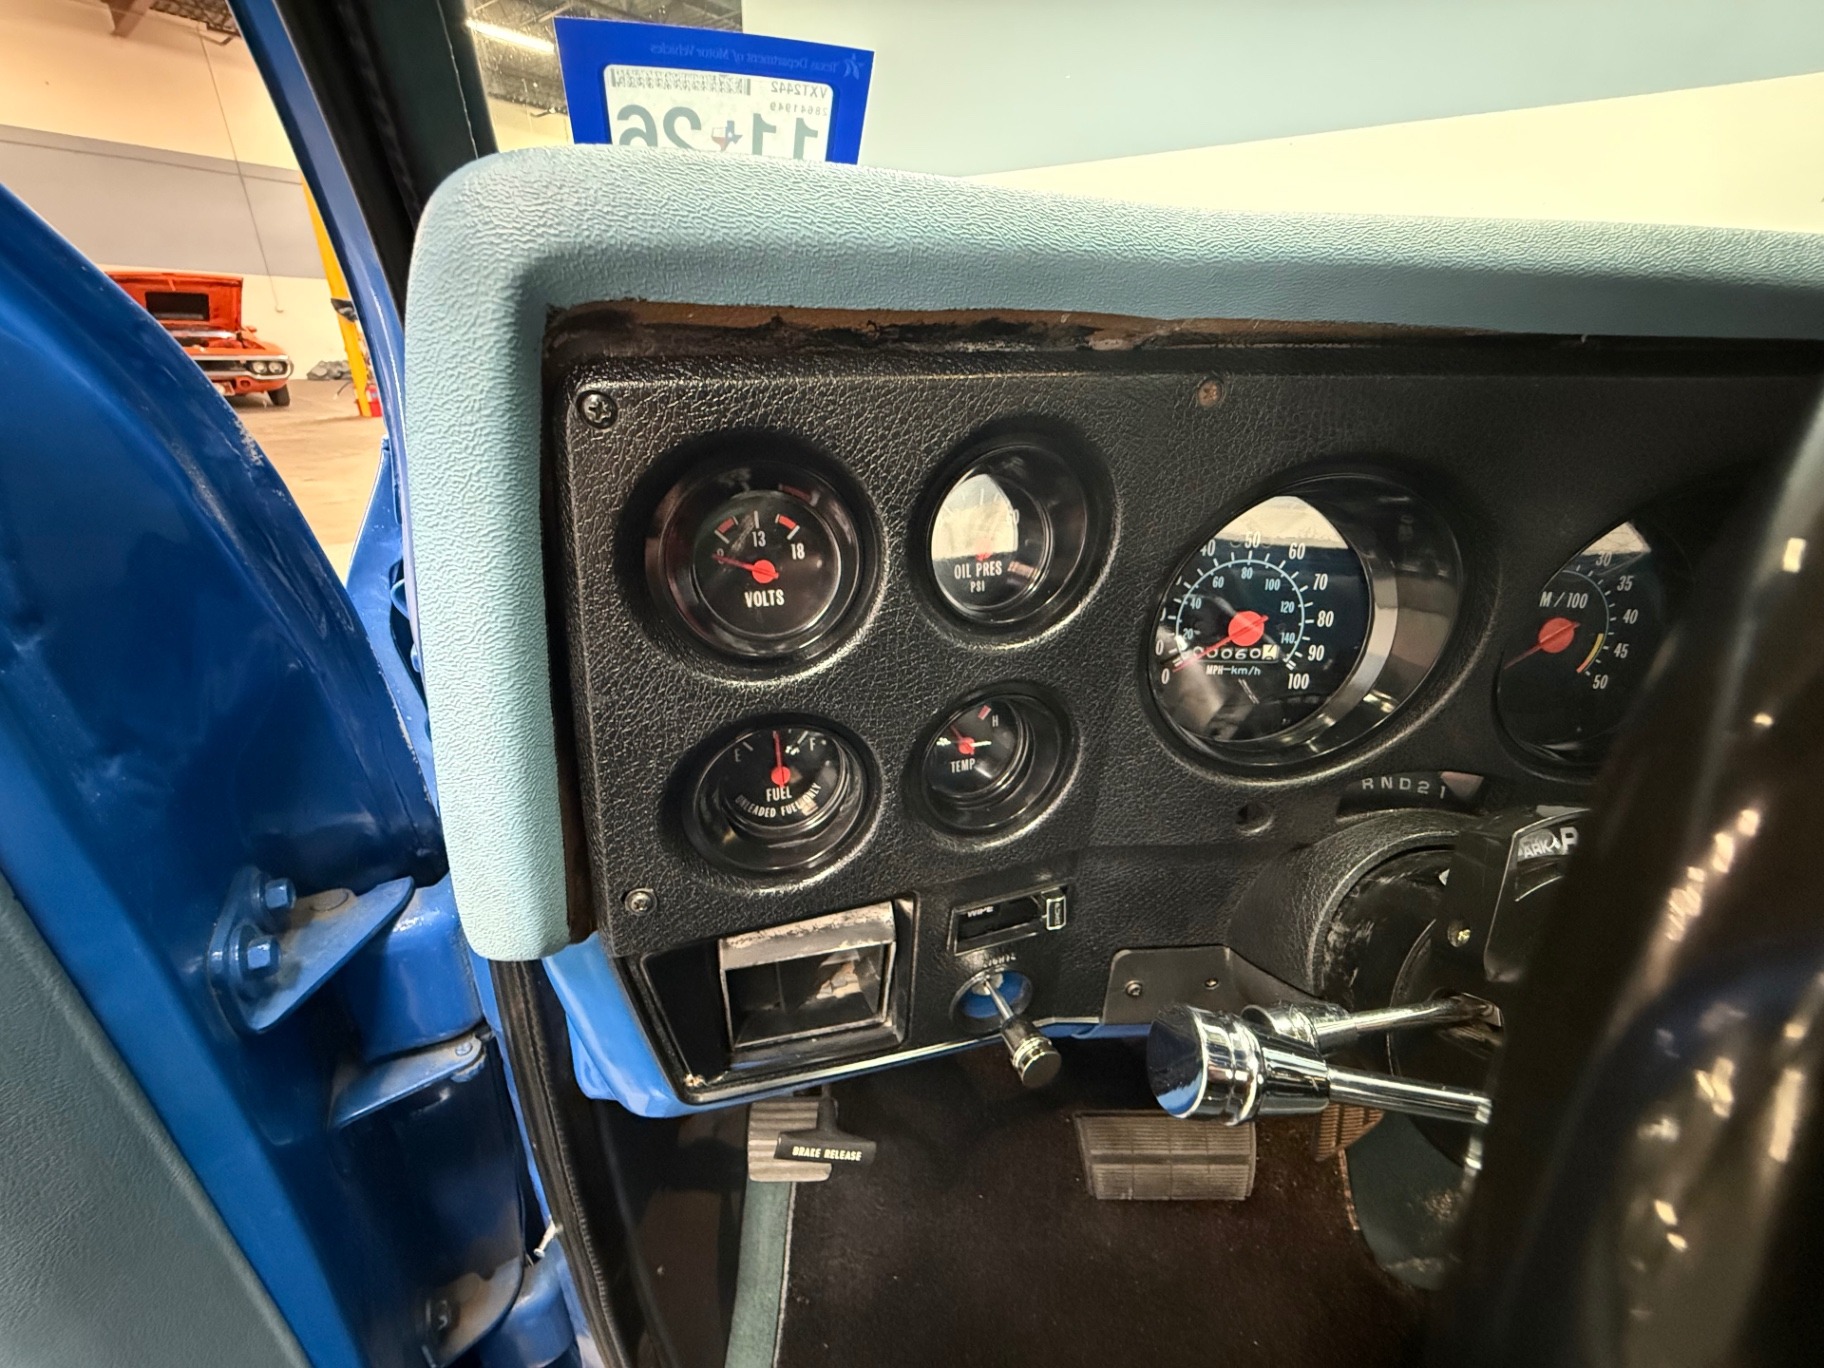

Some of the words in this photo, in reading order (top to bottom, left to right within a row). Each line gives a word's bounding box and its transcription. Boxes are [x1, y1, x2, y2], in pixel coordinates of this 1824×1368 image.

[752, 531, 767, 547] 13
[1244, 531, 1261, 549] 50
[790, 543, 805, 560] 18
[1288, 542, 1306, 560] 60
[1595, 550, 1612, 567] 30
[953, 564, 972, 580] OIL
[975, 560, 1003, 578] PRES
[1241, 566, 1253, 580] 80
[970, 580, 986, 593] PSI
[1212, 575, 1225, 589] 60
[1264, 577, 1281, 591] 100
[1313, 573, 1329, 591] 70
[1617, 575, 1634, 591] 35
[744, 588, 785, 608] VOLTS
[1189, 595, 1202, 610] 40
[1280, 600, 1295, 614] 120
[1317, 610, 1335, 628] 80
[1622, 608, 1639, 624] 40
[1182, 627, 1194, 640] 20
[1280, 632, 1296, 645] 140
[1308, 644, 1325, 661] 90
[1613, 642, 1630, 659] 45
[1161, 668, 1171, 685] 0
[1288, 673, 1310, 690] 100
[1592, 674, 1609, 690] 50
[991, 714, 999, 728] H
[809, 738, 816, 752] F
[734, 749, 742, 763] E
[950, 757, 976, 774] TEMP
[1361, 777, 1374, 791] R
[1380, 775, 1393, 790] N
[1399, 777, 1412, 791] D
[1416, 780, 1430, 795] 2
[734, 793, 777, 818] UNLEADED
[780, 799, 803, 817] FUEL
[802, 782, 823, 802] ONLY
[766, 786, 793, 802] FUEL
[1560, 825, 1580, 855] P
[792, 1145, 822, 1159] BRAKE
[823, 1148, 863, 1162] RELEASE
